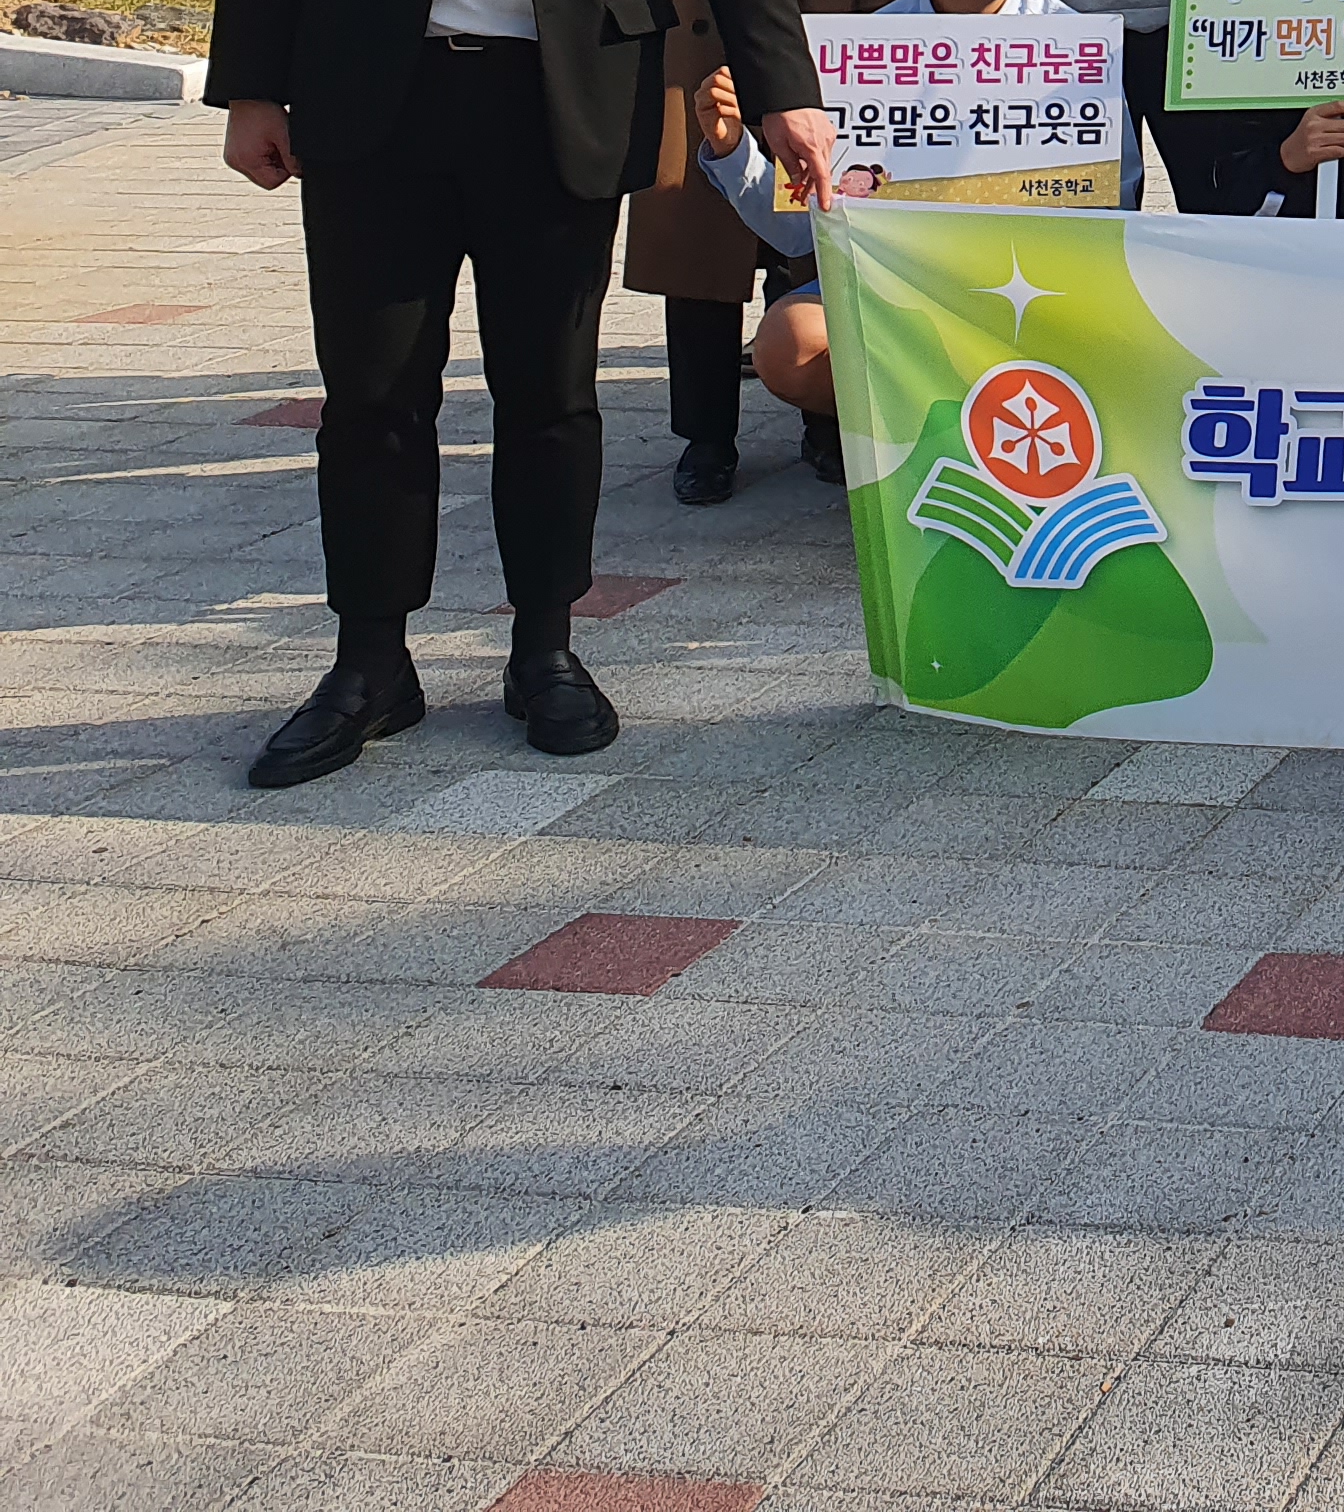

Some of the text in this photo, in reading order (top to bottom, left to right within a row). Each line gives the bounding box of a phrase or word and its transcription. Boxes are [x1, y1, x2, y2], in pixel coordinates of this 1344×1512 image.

[1275, 17, 1334, 59] 먼저
[819, 40, 1106, 86] 나쁜말은 친구눈물
[968, 102, 1106, 147] 친구웃음
[1019, 178, 1094, 197] 사천중학교
